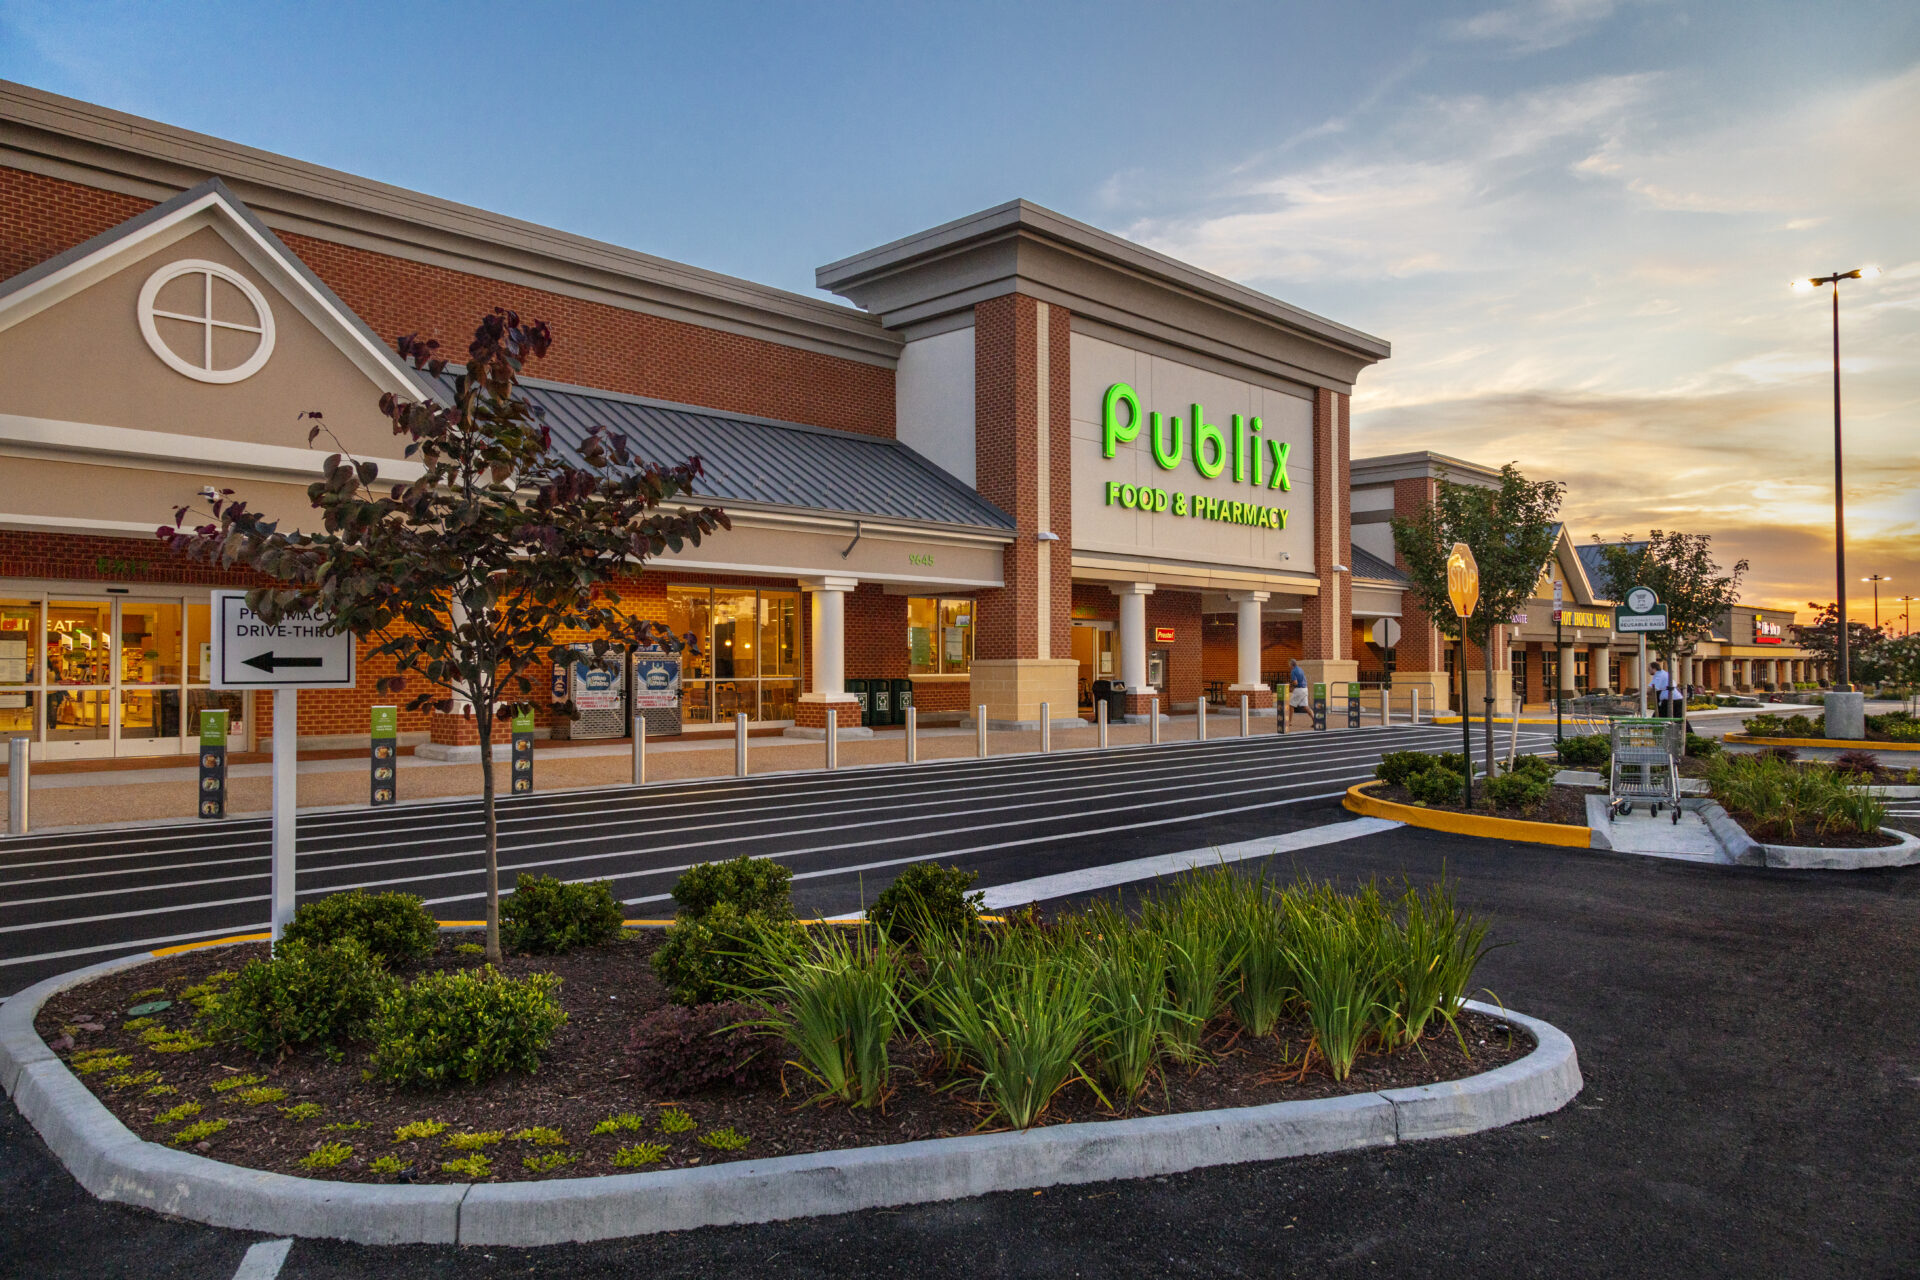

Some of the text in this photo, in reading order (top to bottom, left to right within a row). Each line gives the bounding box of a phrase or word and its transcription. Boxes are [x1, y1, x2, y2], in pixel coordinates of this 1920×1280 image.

[1102, 382, 1291, 492] Publix
[1106, 481, 1290, 530] FOOD & PHARMACY
[909, 554, 935, 567] 9645
[1450, 567, 1476, 593] STOP
[240, 608, 333, 621] PMACY
[1574, 612, 1594, 627] HOUSE
[1595, 614, 1610, 628] YOGA
[237, 625, 335, 638] DRIVE-THRU
